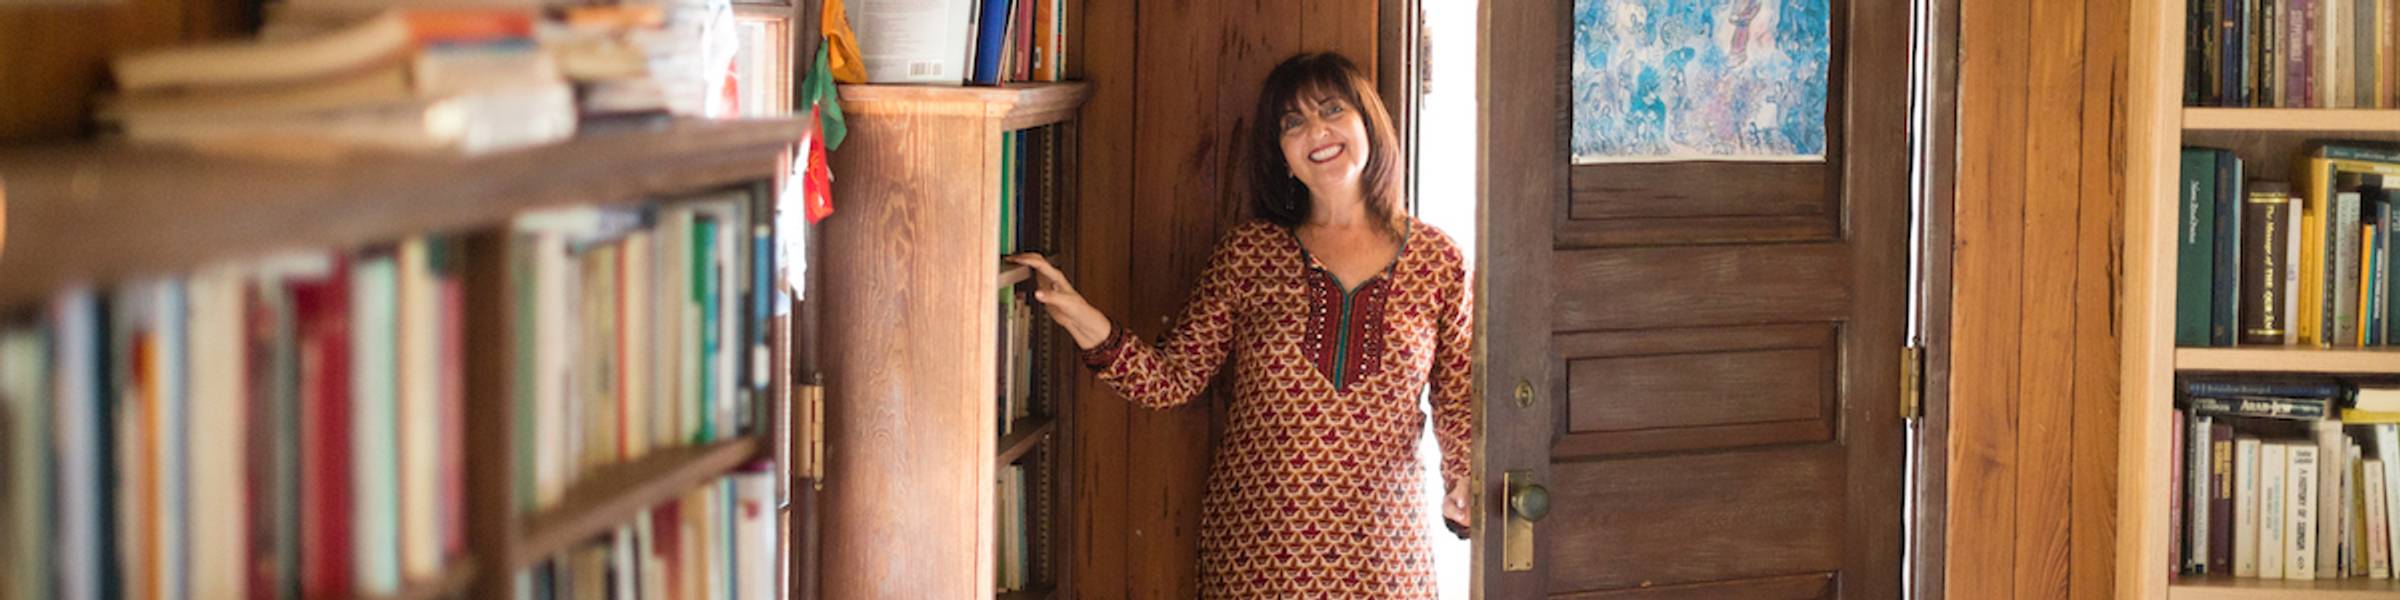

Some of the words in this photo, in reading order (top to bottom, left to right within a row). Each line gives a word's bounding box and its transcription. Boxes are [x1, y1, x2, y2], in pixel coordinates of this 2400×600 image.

[2266, 204, 2275, 219] The
[2264, 221, 2273, 254] Message
[2264, 255, 2272, 266] of
[2264, 267, 2273, 288] THE
[2298, 476, 2307, 506] HISTORY
[2297, 508, 2306, 518] OF
